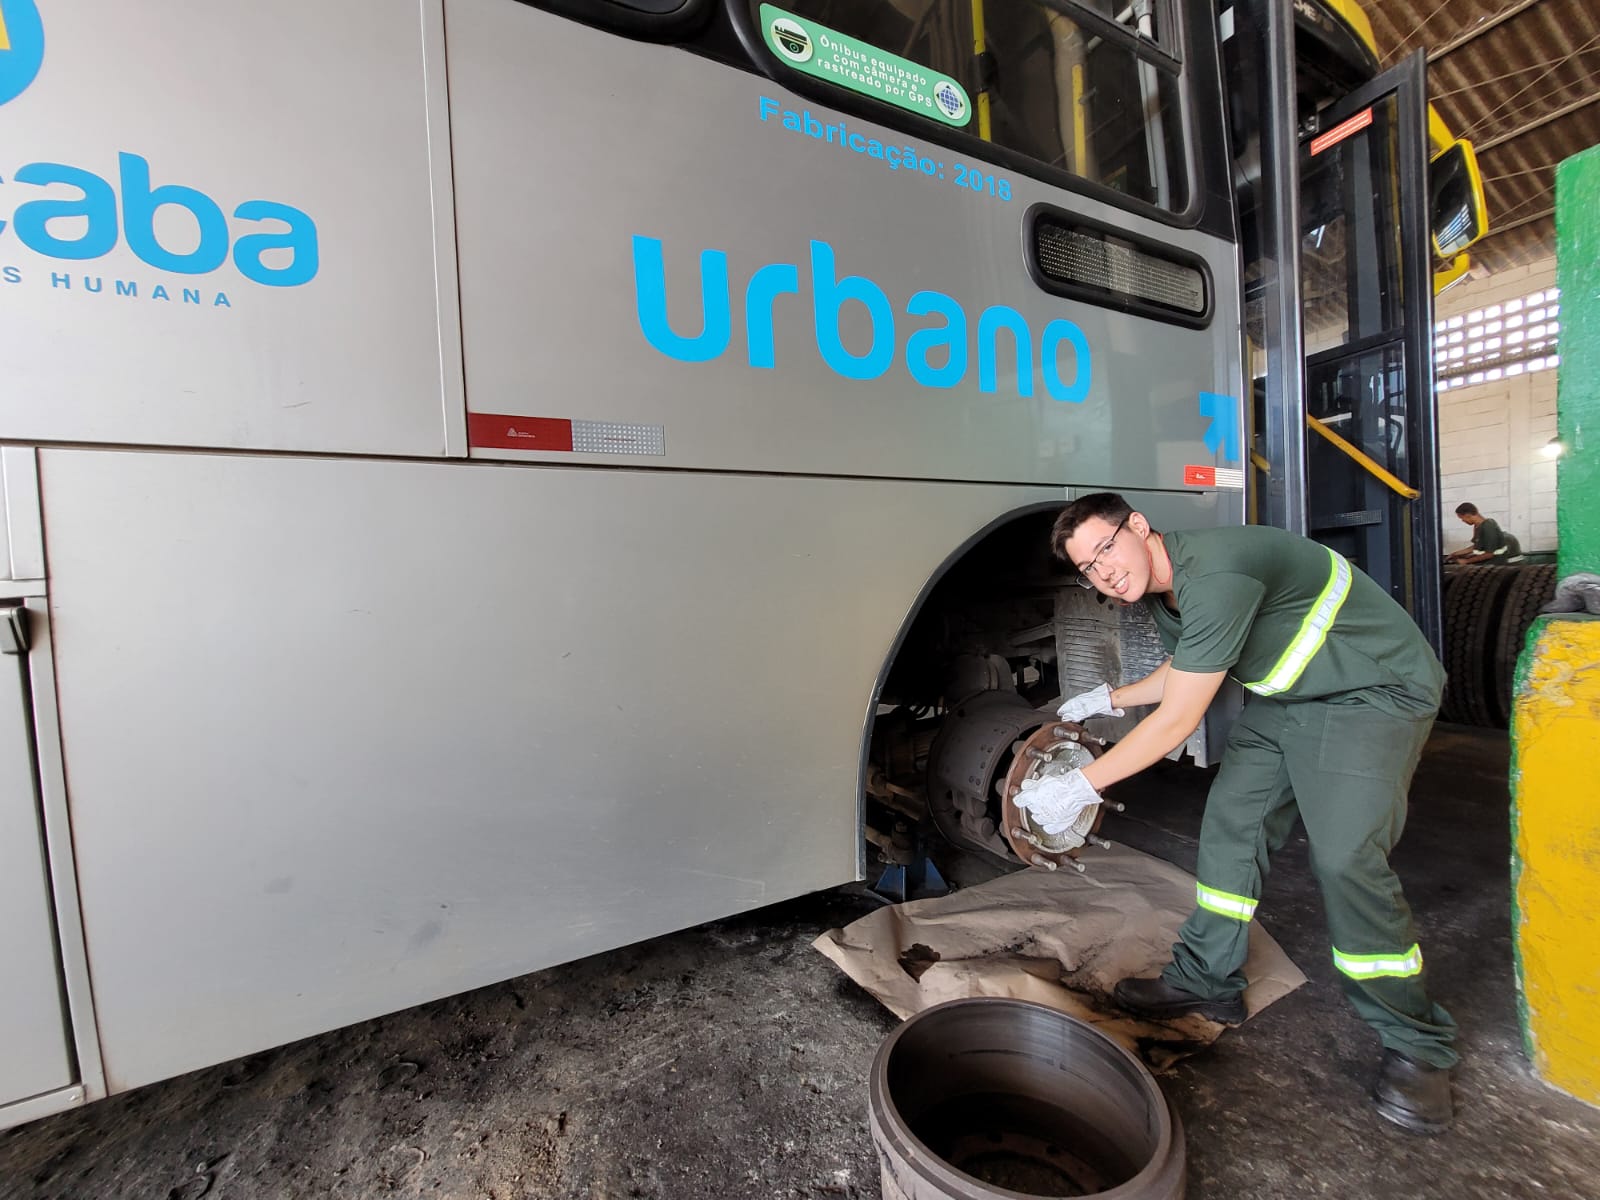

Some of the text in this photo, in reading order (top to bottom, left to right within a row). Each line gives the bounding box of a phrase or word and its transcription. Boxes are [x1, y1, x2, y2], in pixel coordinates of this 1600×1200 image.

[817, 58, 932, 107] rastreado por GPS
[820, 34, 926, 86] Ônibus equipado
[833, 54, 918, 92] com câmera e
[759, 95, 1012, 202] Fabricação: 2018
[0, 151, 319, 287] aba
[51, 271, 232, 308] HUMANA
[632, 235, 1092, 403] urbano
